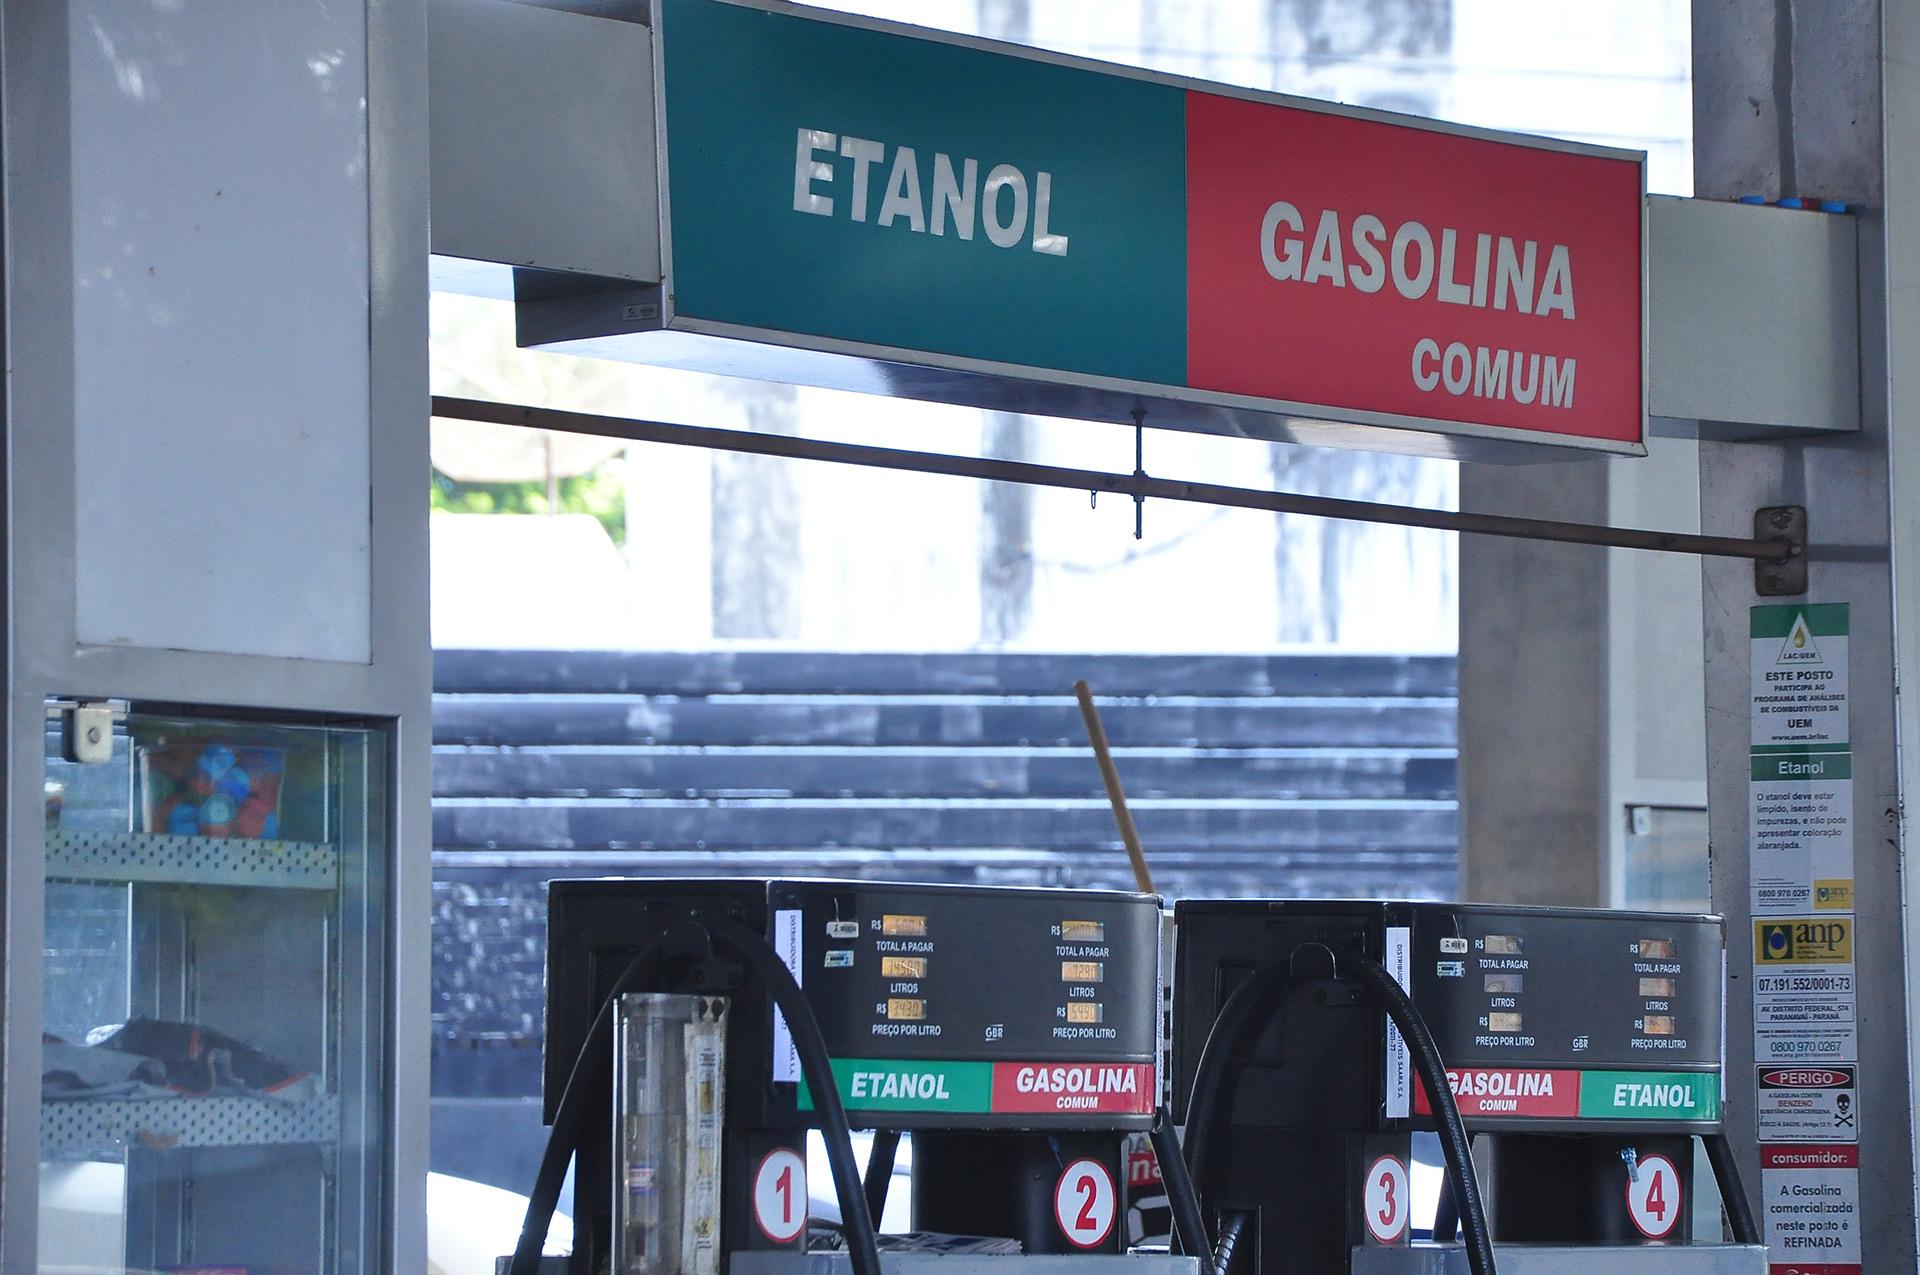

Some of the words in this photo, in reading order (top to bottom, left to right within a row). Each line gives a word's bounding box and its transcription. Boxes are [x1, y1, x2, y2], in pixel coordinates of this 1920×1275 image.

[793, 128, 1069, 257] ETANOL
[1260, 201, 1576, 320] GASOLINA
[1411, 338, 1576, 409] COMUM
[1765, 672, 1794, 681] ESTE
[1797, 670, 1833, 680] POSTO
[1774, 684, 1813, 692] PARTICIPA
[1754, 695, 1796, 703] PROGRAMA
[1809, 694, 1845, 702] ANÁLISES
[1771, 705, 1828, 713] COMBUSTÍVEIS
[1788, 719, 1813, 728] UEM
[1778, 761, 1824, 774] Etanol
[1757, 793, 1764, 801] O
[1765, 792, 1791, 801] etanol
[1792, 792, 1812, 800] deve
[1791, 805, 1816, 813] isento
[1827, 817, 1847, 826] pode
[1757, 830, 1801, 838] apresentar
[1802, 828, 1842, 838] coloração
[871, 919, 882, 931] R$
[1050, 925, 1061, 935] R$
[1796, 922, 1845, 952] anp
[876, 941, 900, 951] TOTAL
[901, 941, 908, 951] A
[907, 942, 934, 952] PAGAR
[1474, 939, 1484, 950] R$
[1630, 944, 1639, 954] R$
[1056, 946, 1078, 957] TOTAL
[1078, 947, 1086, 956] A
[1085, 947, 1110, 957] PAGAR
[1479, 959, 1500, 968] TOTAL
[1500, 959, 1507, 968] A
[1506, 960, 1529, 969] PAGAR
[1634, 963, 1653, 972] TOTAL
[1653, 963, 1660, 972] A
[1659, 964, 1681, 973] PAGAR
[890, 983, 919, 993] LITROS
[1759, 977, 1850, 991] 07.191.552/0001-73
[1069, 987, 1095, 997] LITROS
[1491, 998, 1515, 1007] LITROS
[1645, 1001, 1668, 1011] LITROS
[876, 1003, 887, 1014] R$
[1056, 1007, 1066, 1018] R$
[1772, 1005, 1803, 1013] DISTRITO
[1479, 1016, 1488, 1027] R$
[1634, 1019, 1643, 1029] R$
[872, 1024, 899, 1037] PREÇO
[900, 1025, 918, 1035] POR
[918, 1025, 942, 1036] LITRO
[985, 1028, 1003, 1038] GBR
[1053, 1027, 1078, 1040] PREÇO
[1078, 1028, 1094, 1038] POR
[1095, 1028, 1116, 1039] LITRO
[1475, 1036, 1499, 1048] PREÇO
[1499, 1036, 1515, 1046] POR
[1515, 1036, 1535, 1046] LITRO
[1572, 1038, 1589, 1048] GBR
[1631, 1039, 1653, 1050] PREÇO
[1654, 1039, 1668, 1048] POR
[1668, 1039, 1687, 1049] LITRO
[1771, 1042, 1795, 1052] 0800
[1797, 1042, 1816, 1052] 970
[1818, 1041, 1842, 1052] 0267
[1016, 1067, 1137, 1093] GASOLINA
[1780, 1073, 1833, 1084] PERIGO
[850, 1072, 950, 1100] ETANOL
[1448, 1072, 1553, 1097] GASOLINA
[1613, 1084, 1696, 1108] ETANOL
[1056, 1096, 1099, 1109] COMUM
[1479, 1099, 1517, 1111] COMUM
[1771, 1151, 1848, 1164] consumidor:
[775, 1165, 791, 1224] 1
[1780, 1184, 1789, 1196] A
[1792, 1184, 1841, 1196] Gasolina
[1378, 1171, 1396, 1226] 3
[1645, 1170, 1665, 1222] 4
[1074, 1174, 1097, 1231] 2
[1770, 1201, 1853, 1214] comercializada
[1776, 1220, 1805, 1231] neste
[1808, 1220, 1839, 1233] posto
[1842, 1219, 1849, 1231] é
[1783, 1236, 1842, 1248] REFINADA
